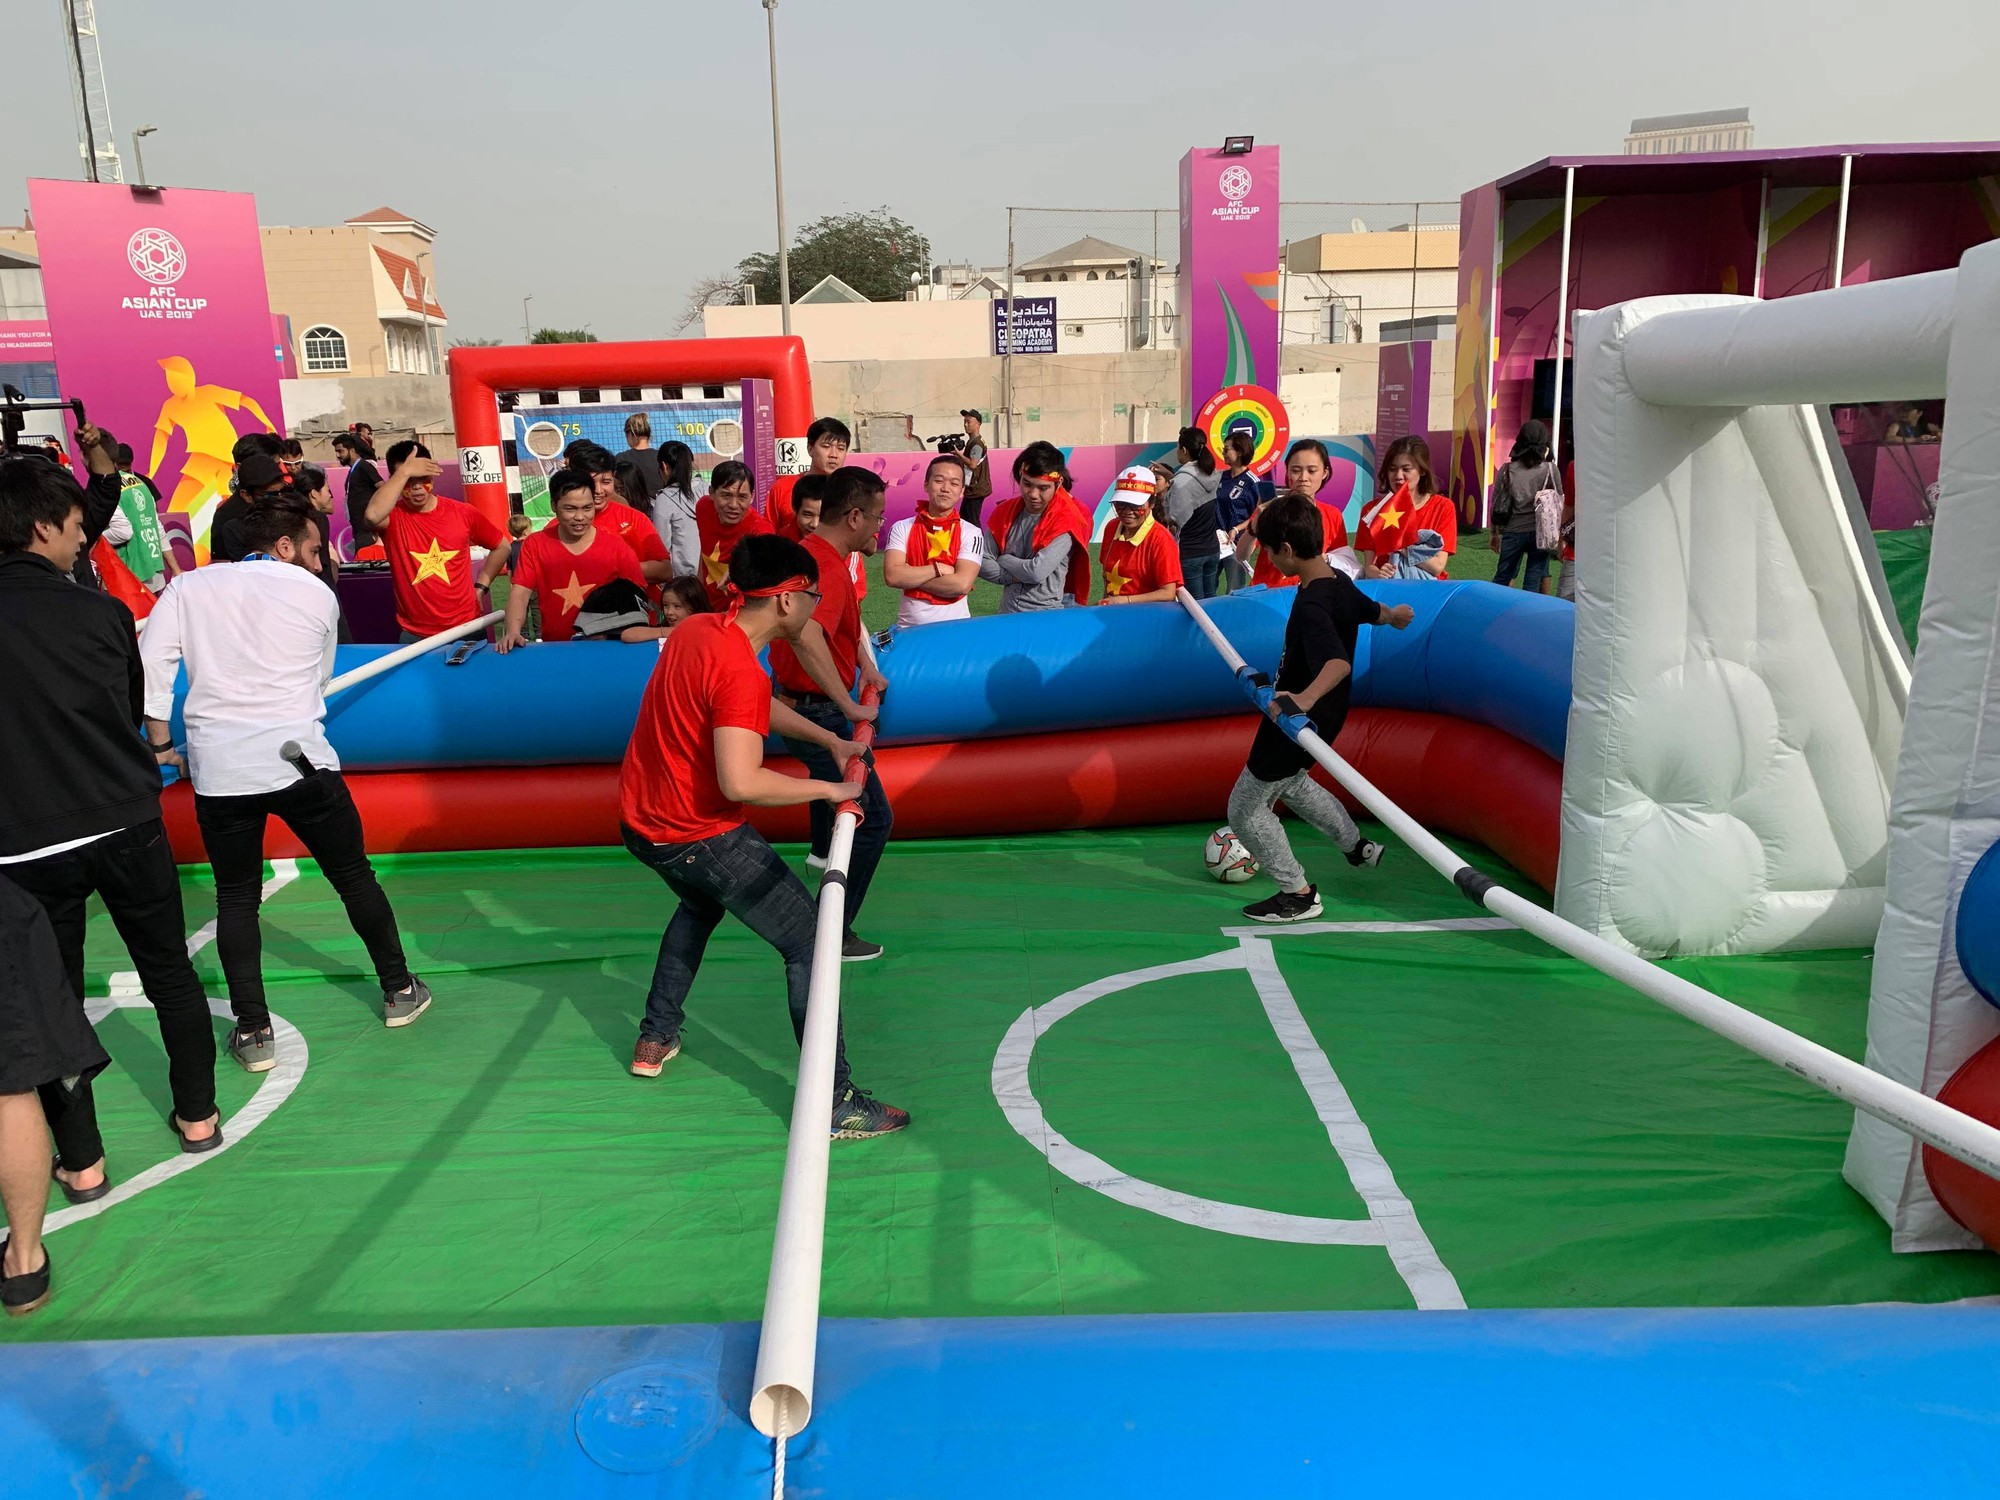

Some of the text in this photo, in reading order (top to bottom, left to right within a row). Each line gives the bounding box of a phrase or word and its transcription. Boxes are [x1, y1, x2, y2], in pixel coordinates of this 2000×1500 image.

[1211, 206, 1260, 216] ASIAN CUP
[149, 286, 176, 297] AFC
[121, 296, 207, 310] ASIAN CUP
[139, 310, 163, 318] UAE
[1027, 338, 1053, 346] ACADEMY
[561, 423, 581, 436] 75
[676, 422, 705, 436] 100
[483, 472, 502, 482] OFF
